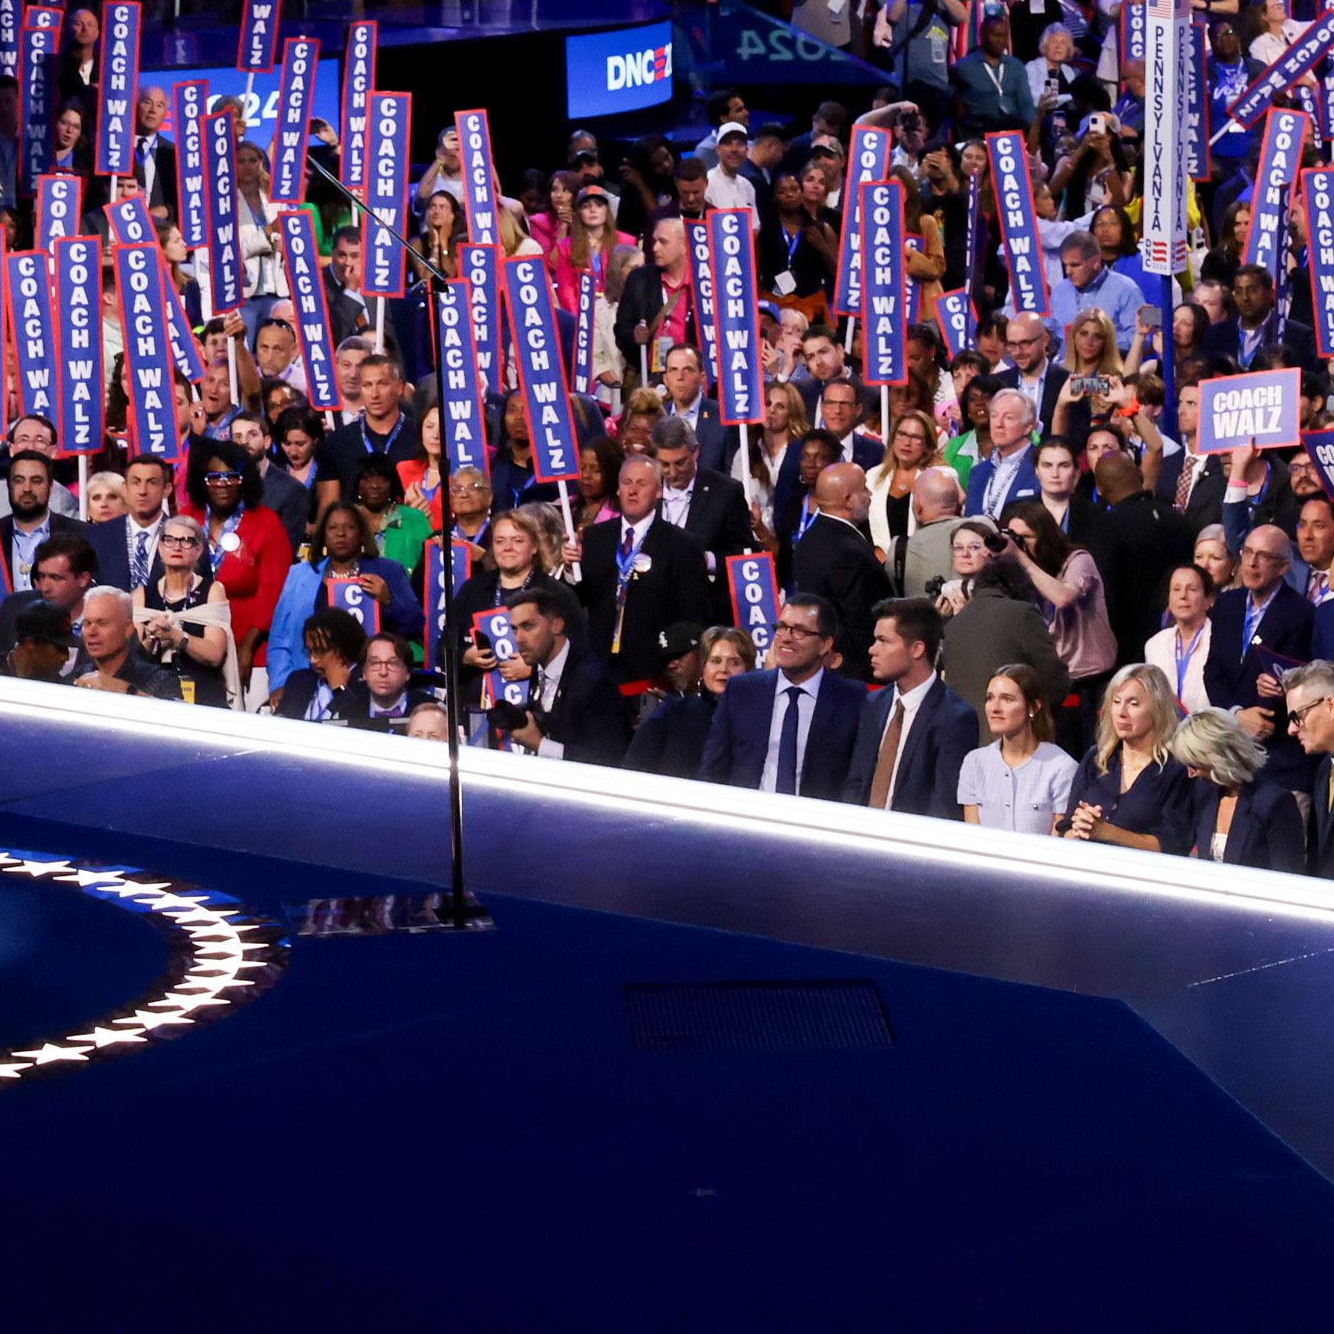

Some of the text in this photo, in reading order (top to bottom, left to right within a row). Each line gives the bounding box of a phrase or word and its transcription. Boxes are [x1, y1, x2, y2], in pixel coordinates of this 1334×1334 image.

[607, 55, 656, 90] DNC
[1151, 25, 1164, 232] PENNSYLVANIA
[1176, 25, 1185, 232] PENNSYLVANIA
[721, 215, 749, 412] COACH WALZ
[873, 187, 894, 374] COACH WALZ
[997, 137, 1036, 309] COACH WALZ
[69, 242, 93, 443] COACH WALZ
[128, 251, 165, 452] COACH WALZ
[516, 263, 565, 468] COACH WALZ
[1212, 386, 1282, 413] COACH
[1212, 407, 1282, 439] WALZ
